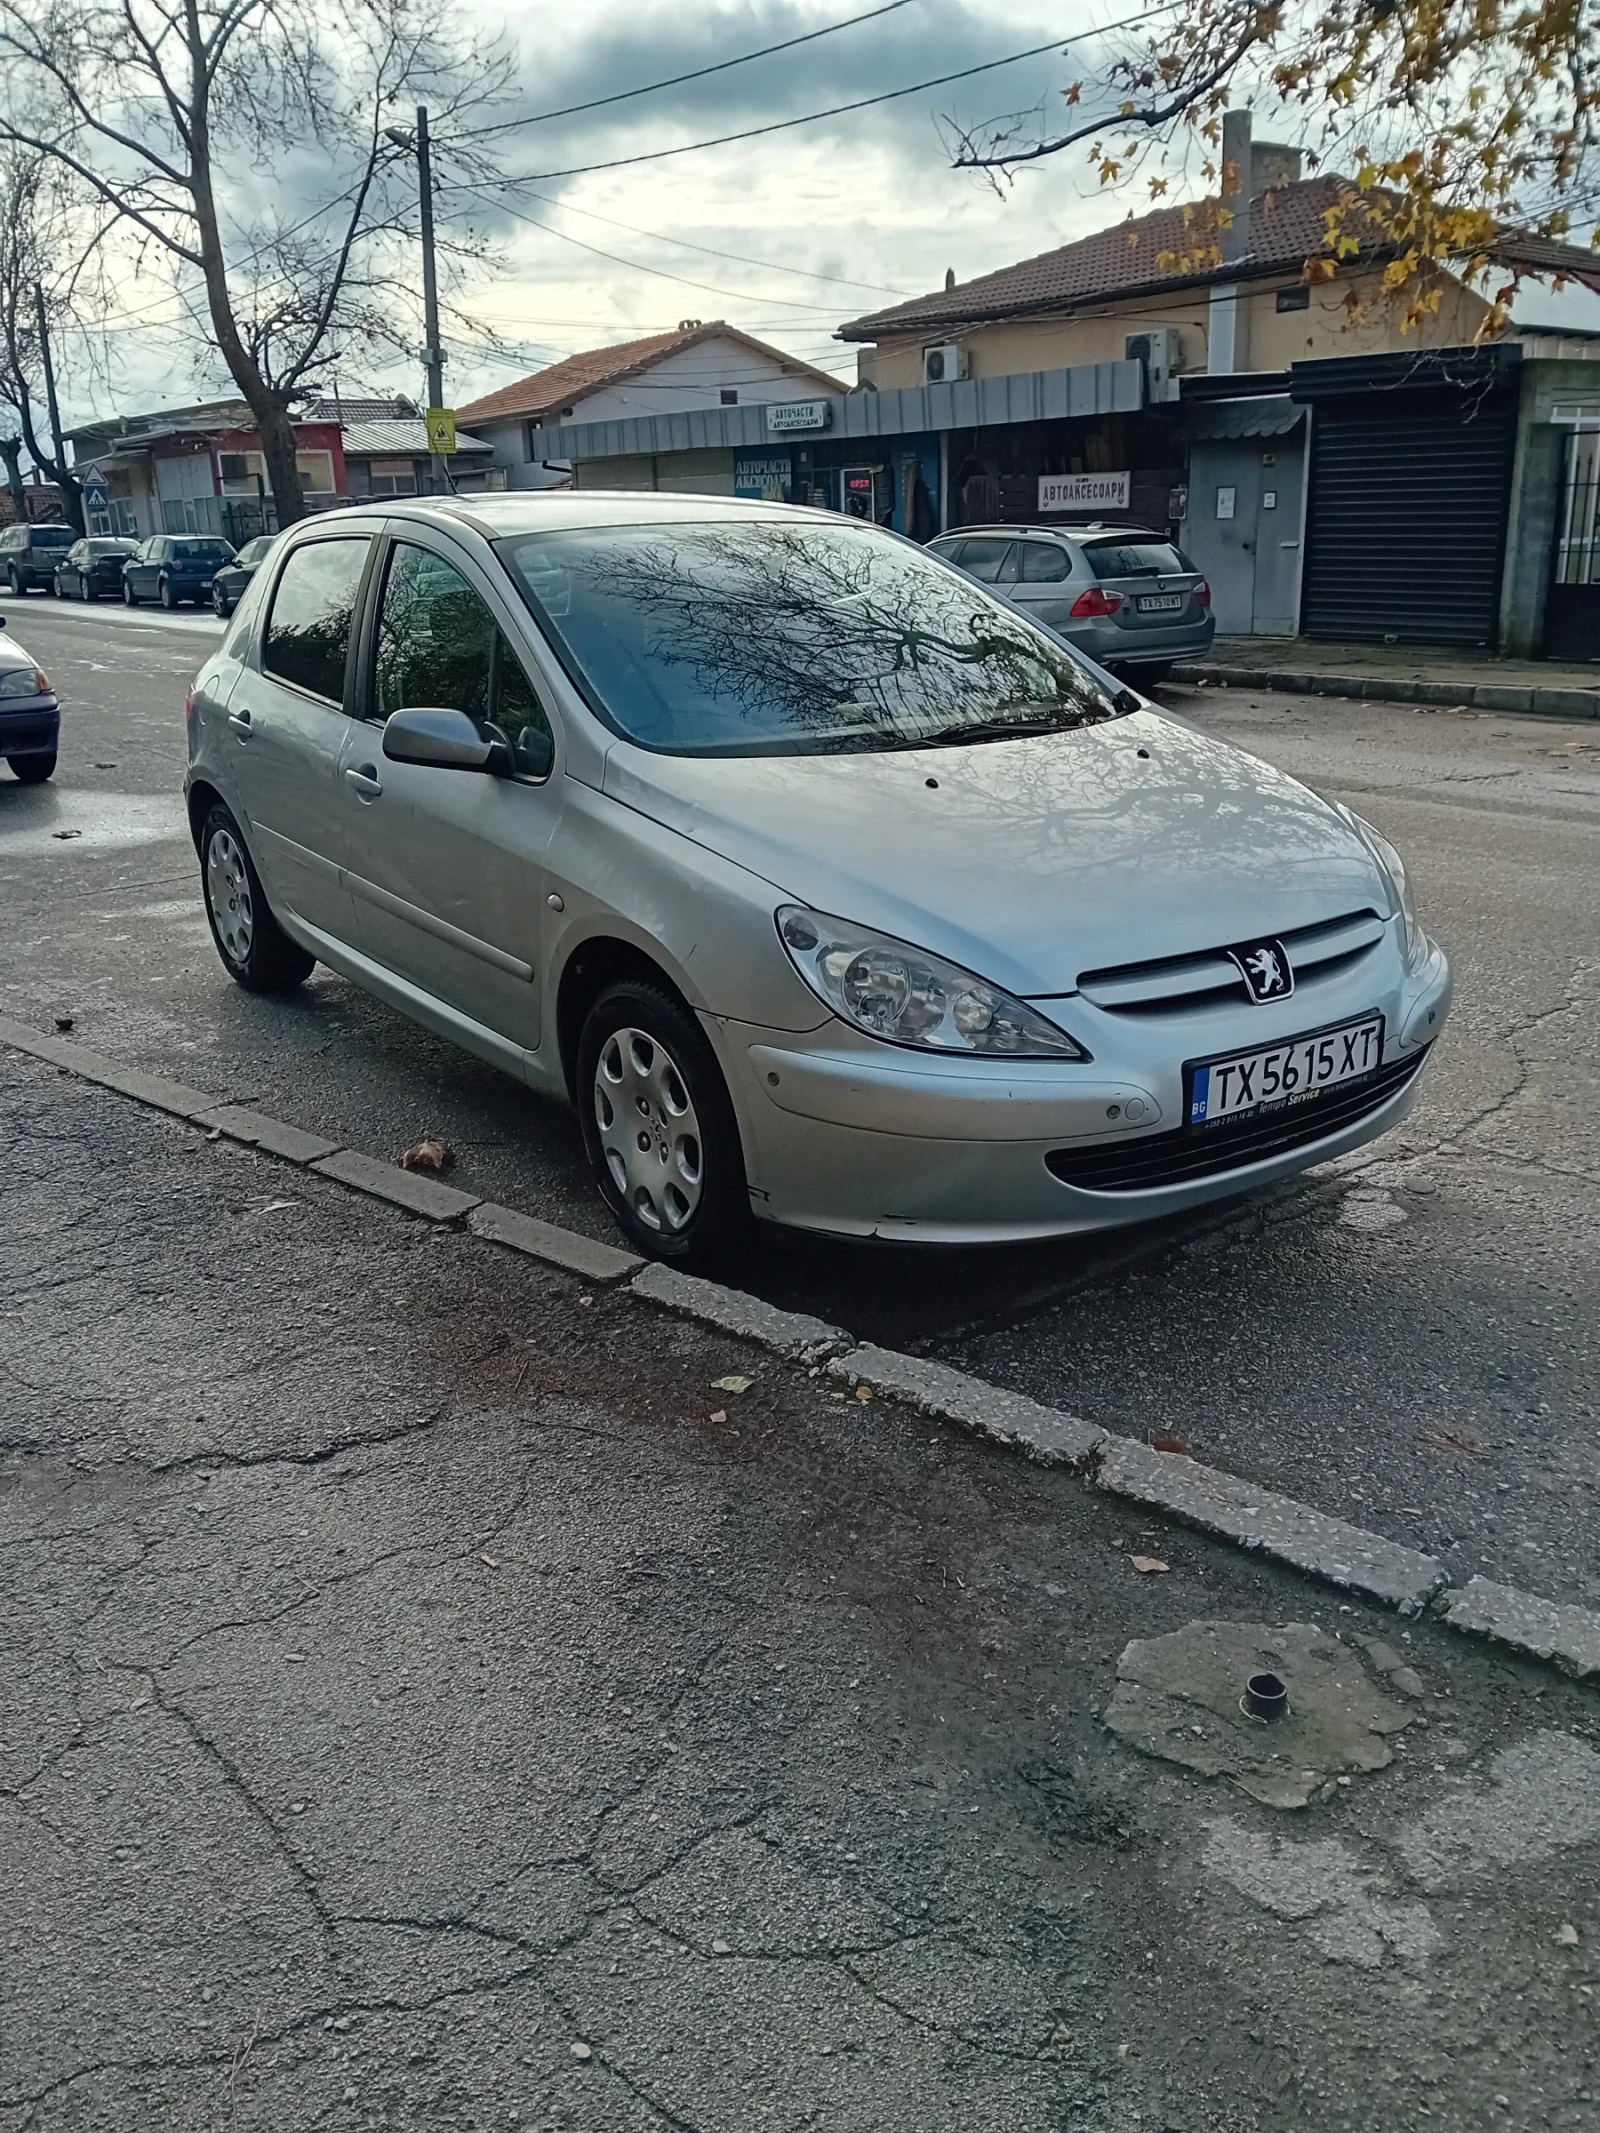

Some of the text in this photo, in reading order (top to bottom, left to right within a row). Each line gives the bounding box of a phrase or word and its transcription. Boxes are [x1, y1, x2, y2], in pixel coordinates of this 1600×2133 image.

[775, 406, 814, 419] АВТОЧАСТИ
[735, 459, 791, 474] АВТОЧАСТИ
[849, 479, 870, 488] OPEN
[1043, 482, 1125, 501] АВТОАКСЕСОАРИ
[1192, 1101, 1206, 1116] BG
[1259, 1088, 1320, 1114] Tempo Service
